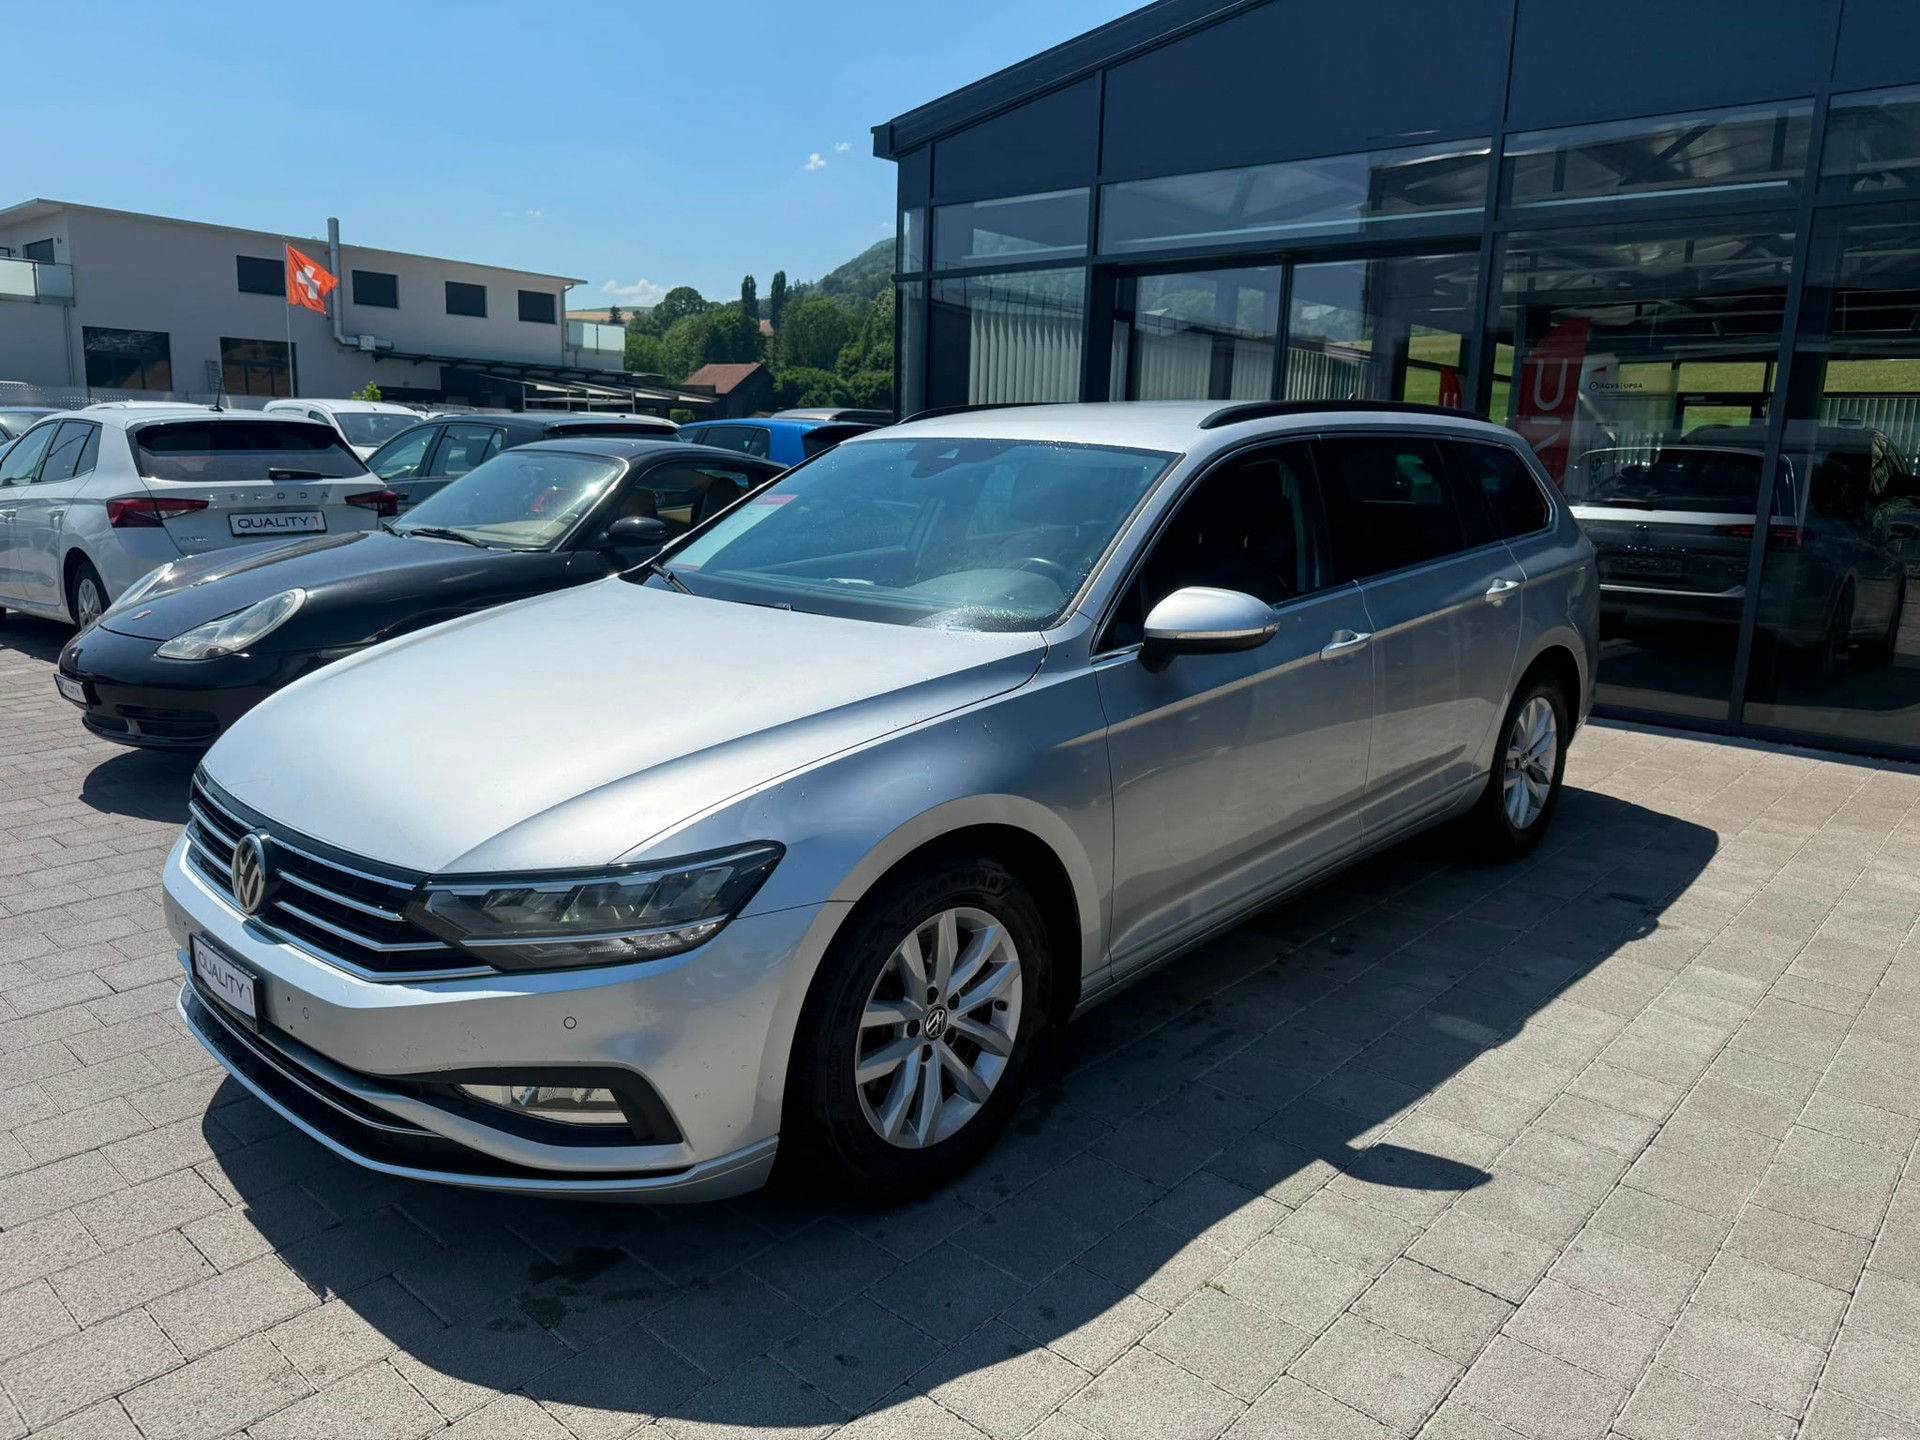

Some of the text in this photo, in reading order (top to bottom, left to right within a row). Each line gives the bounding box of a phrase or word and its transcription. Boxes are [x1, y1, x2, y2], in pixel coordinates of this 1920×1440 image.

[237, 515, 319, 529] QUALITY 1
[198, 950, 253, 1005] QUALITY 1
